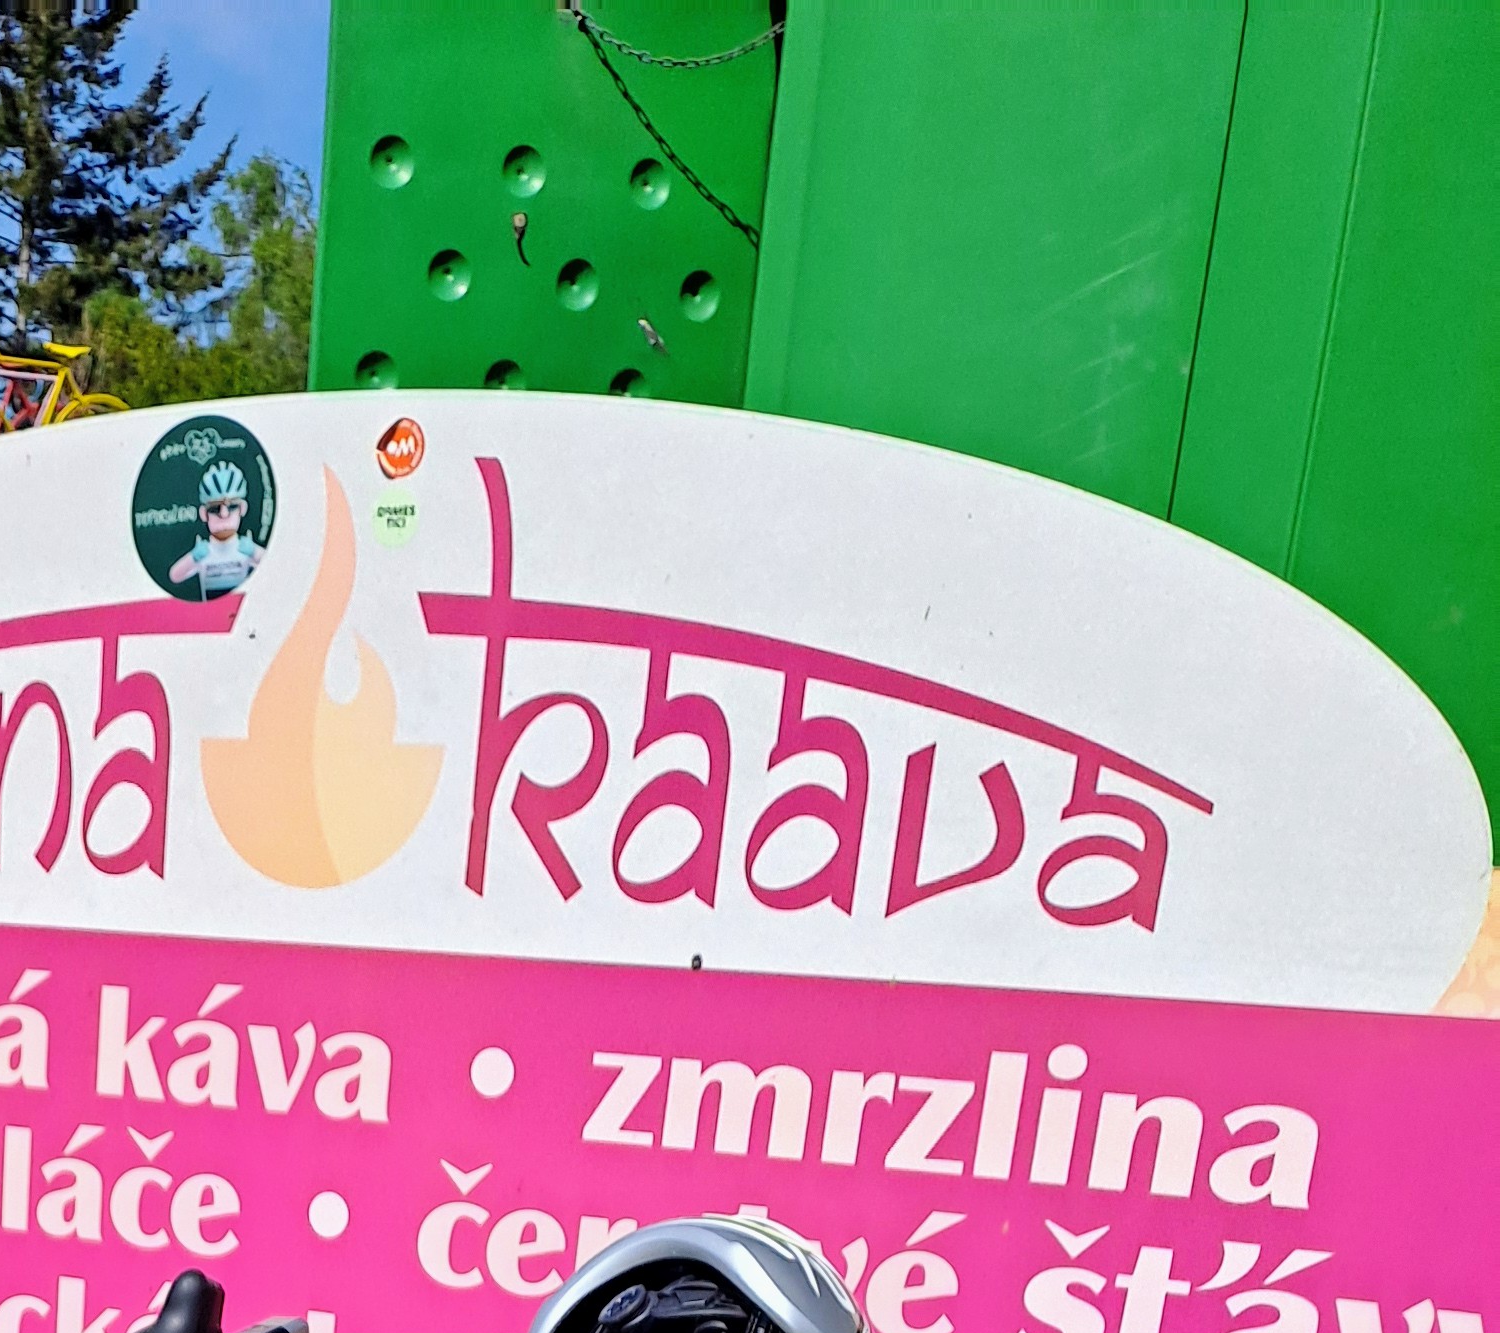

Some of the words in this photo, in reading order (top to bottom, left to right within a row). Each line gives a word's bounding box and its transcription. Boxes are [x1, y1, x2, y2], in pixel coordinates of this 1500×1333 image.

[418, 456, 1214, 933] kaava
[95, 983, 393, 1123] káva
[581, 1044, 1320, 1210] zmrzlina
